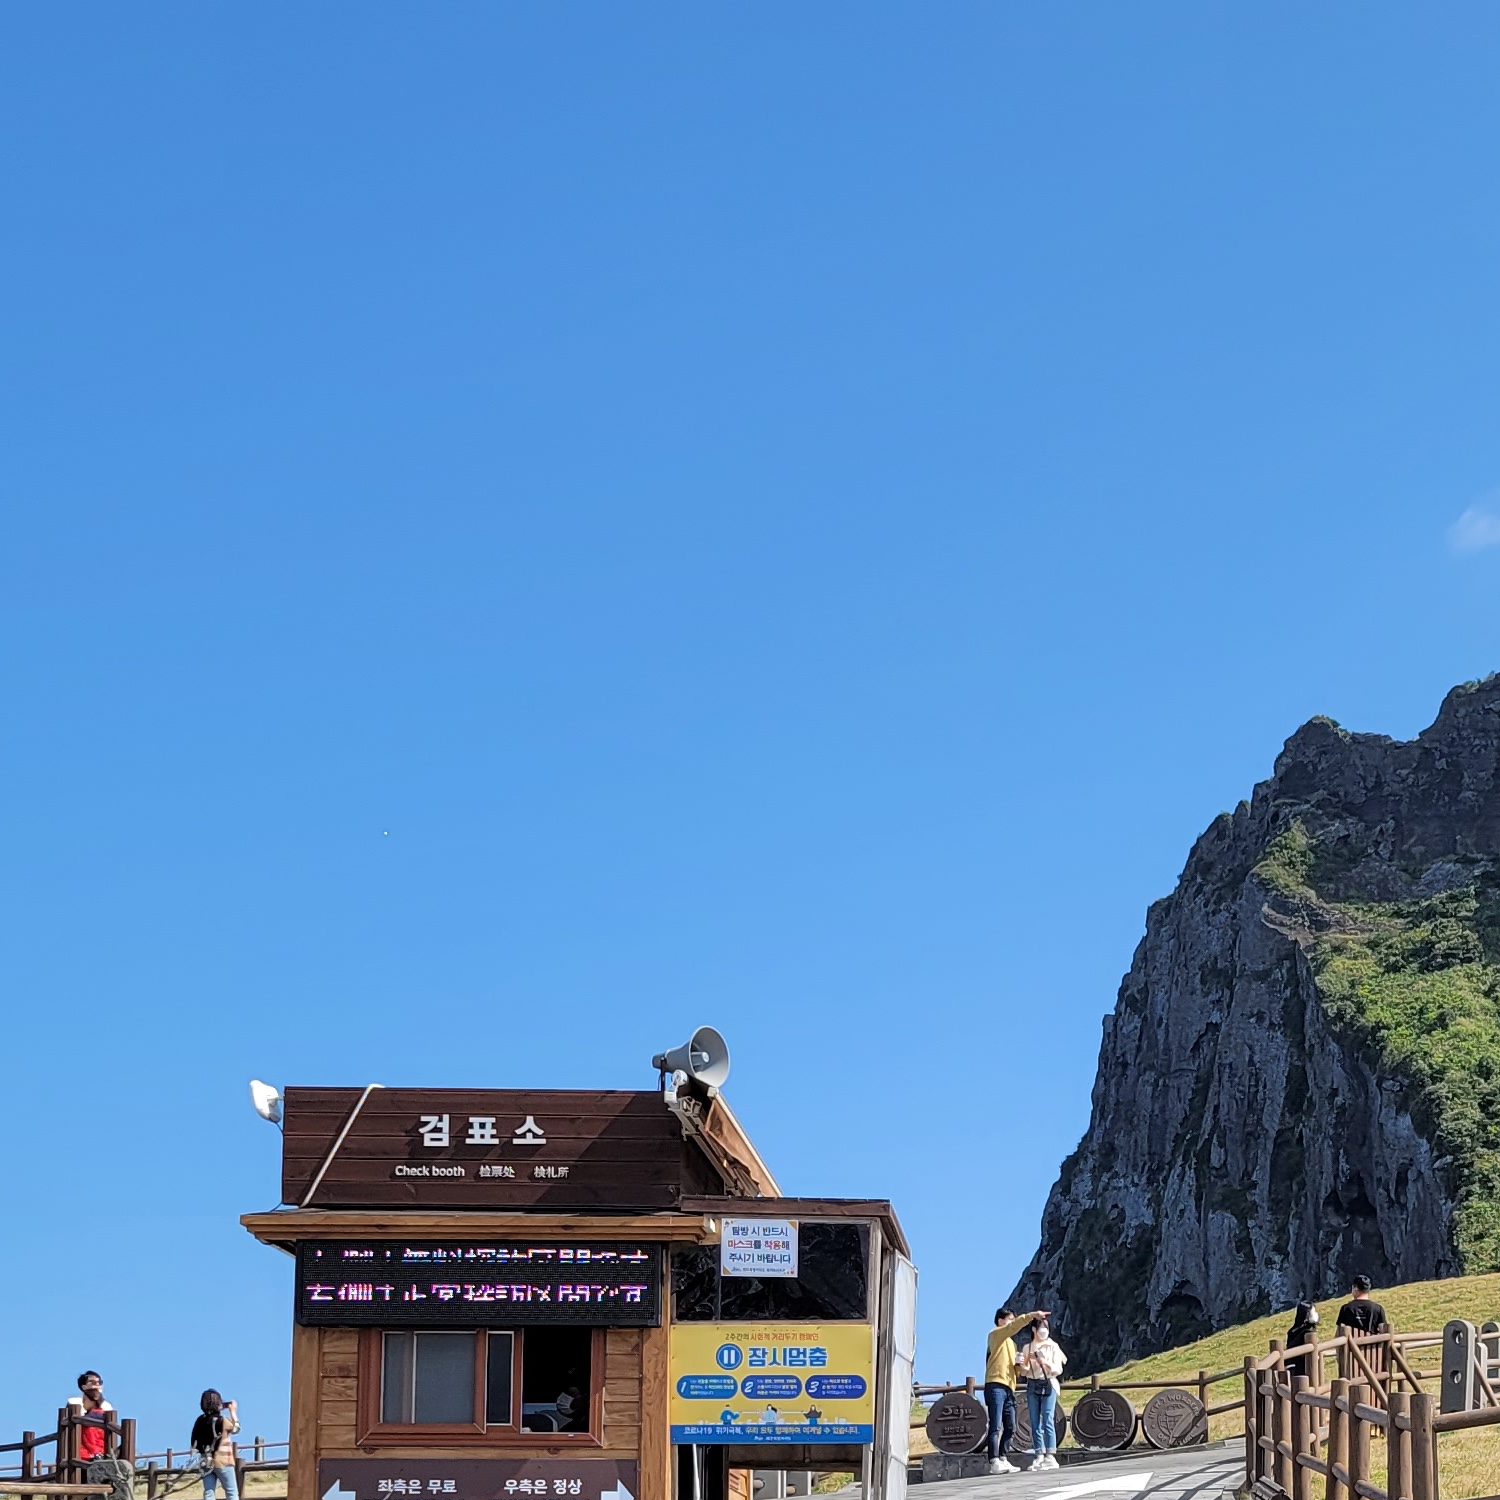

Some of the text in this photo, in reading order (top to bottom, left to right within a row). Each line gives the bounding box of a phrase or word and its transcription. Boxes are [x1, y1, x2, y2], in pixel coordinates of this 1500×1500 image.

[418, 1114, 547, 1147] 검표소
[395, 1166, 465, 1177] Check booth
[732, 1226, 788, 1236] 탐방 시 반드시
[728, 1240, 790, 1250] 마스크를 착용해
[729, 1253, 791, 1264] 주시기 바랍니다
[748, 1346, 828, 1367] 잠시멈춤
[681, 1382, 687, 1393] 1
[744, 1381, 754, 1393] 2
[808, 1381, 819, 1393] 3
[684, 1427, 712, 1435] 코로나19
[378, 1479, 457, 1494] 좌측은 무료
[504, 1479, 582, 1495] 우측은 정상
